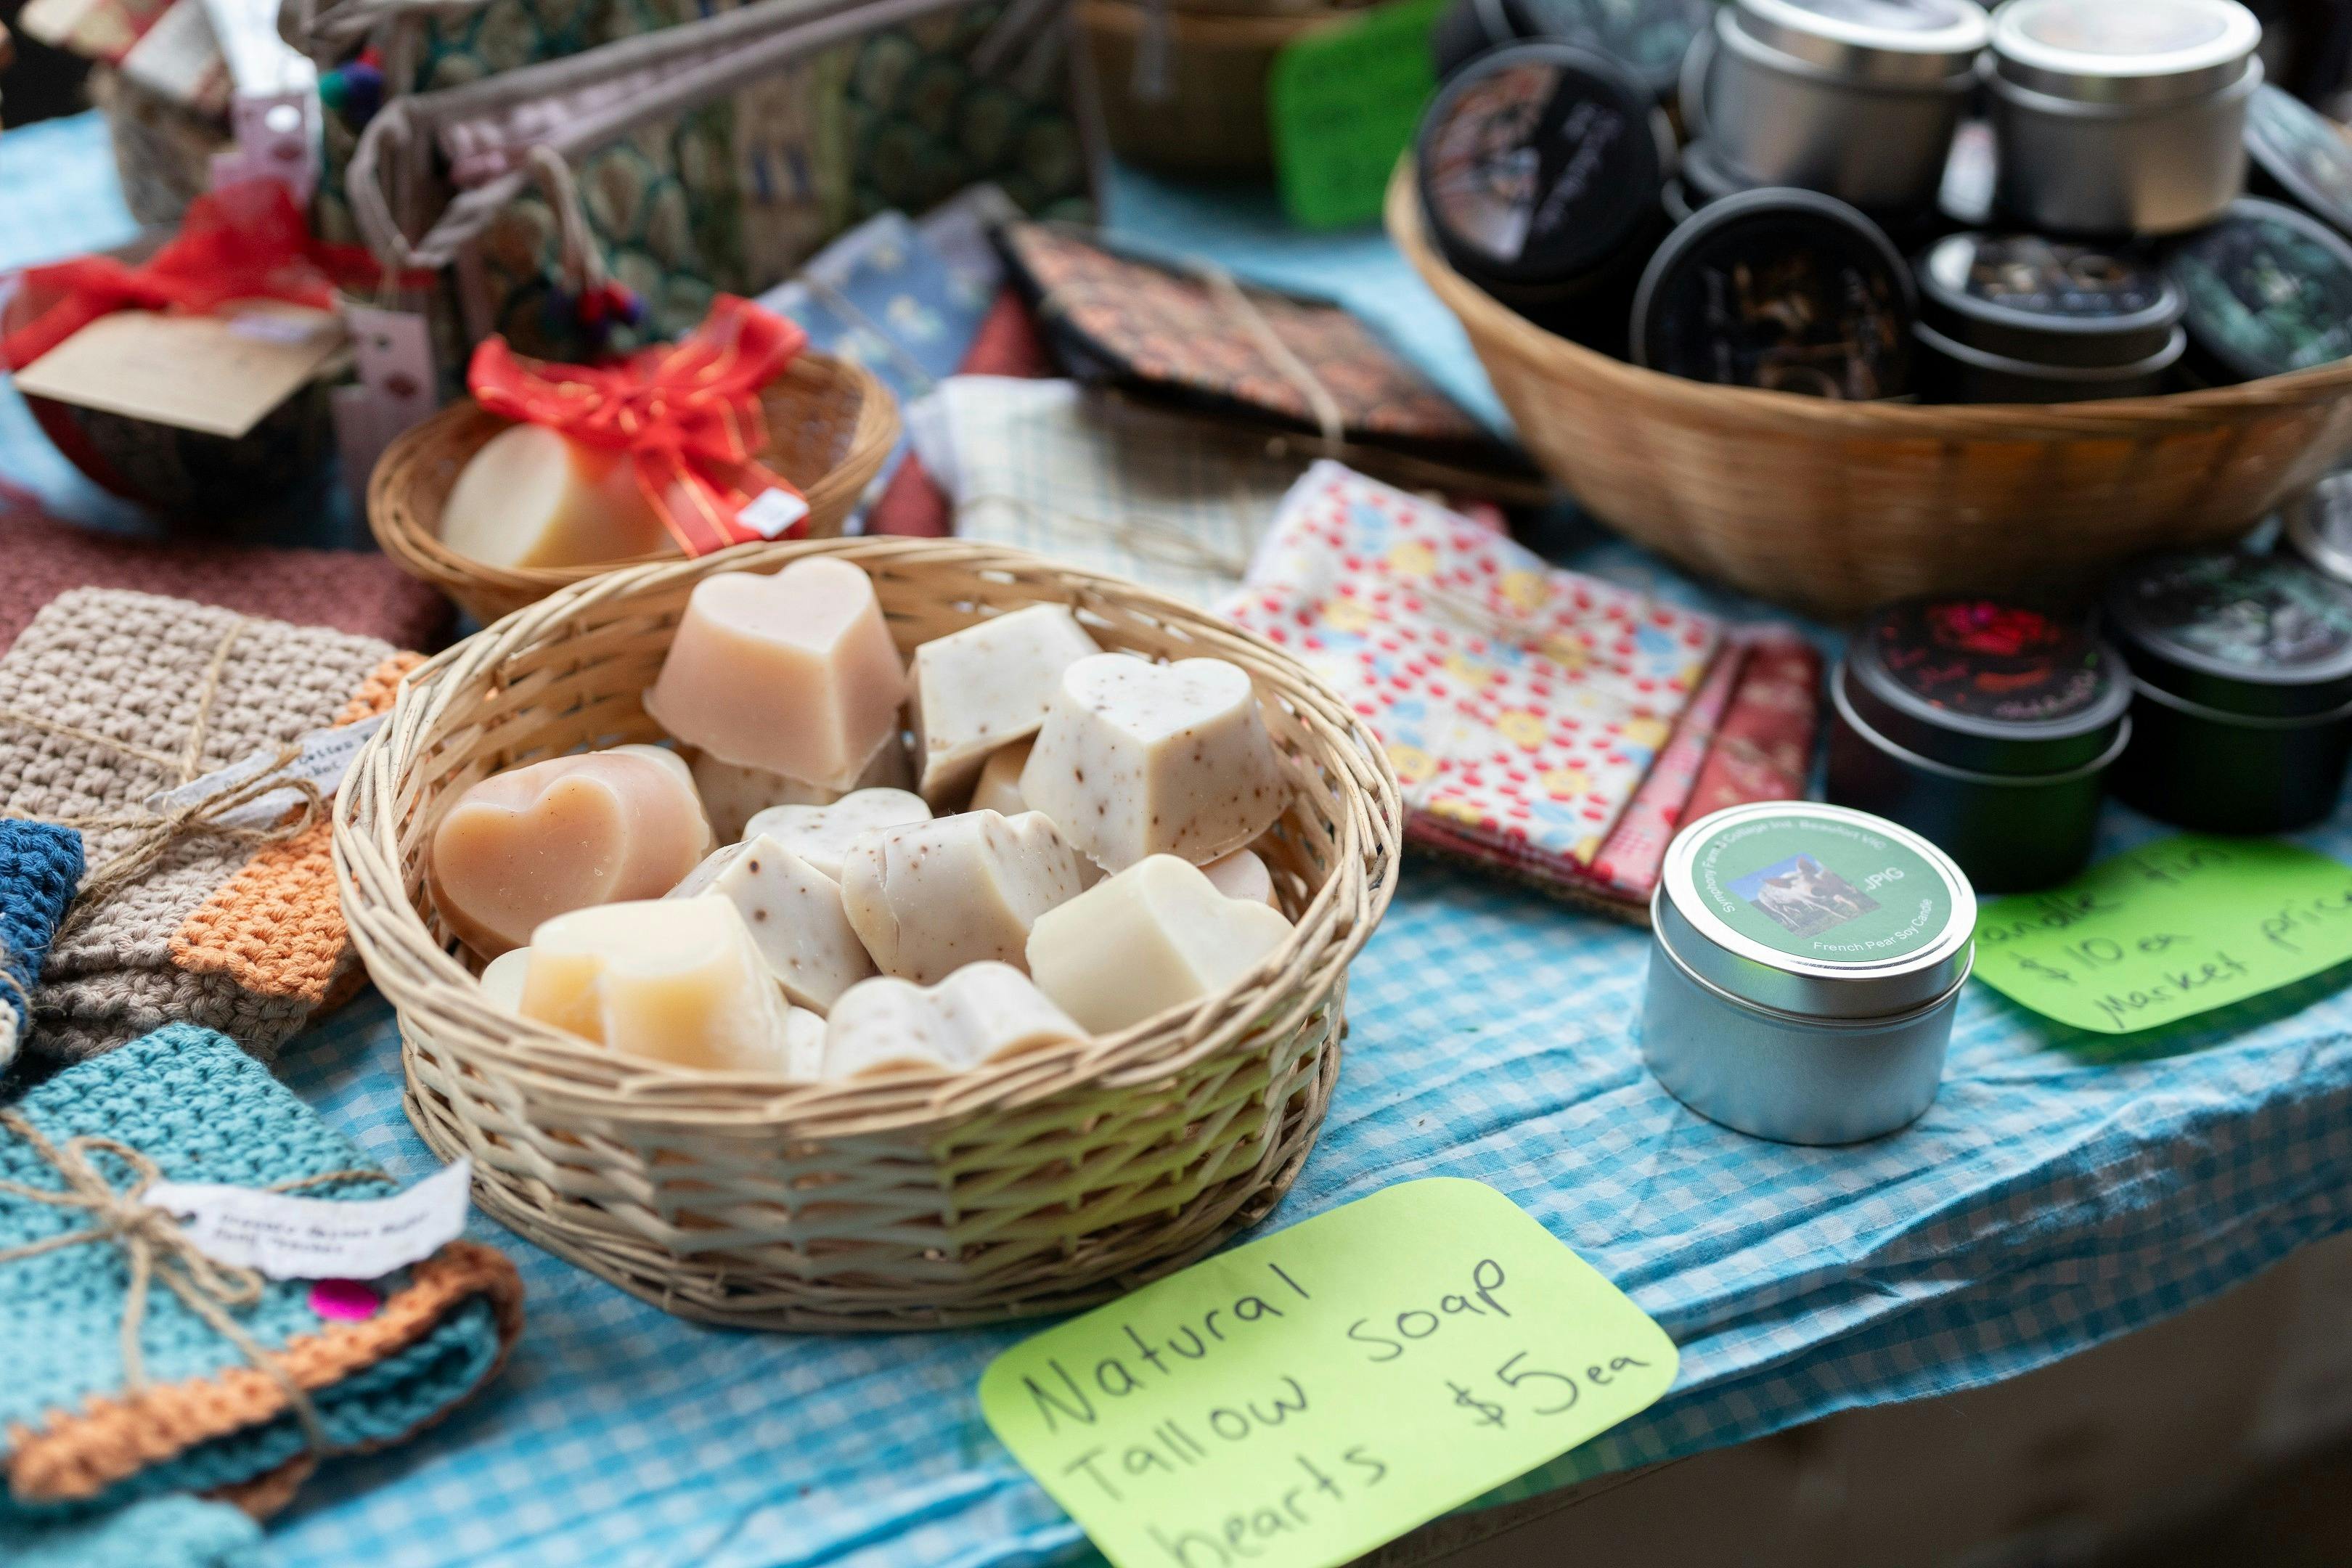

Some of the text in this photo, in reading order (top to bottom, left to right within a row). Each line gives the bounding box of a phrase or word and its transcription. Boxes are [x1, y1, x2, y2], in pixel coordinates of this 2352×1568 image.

[1702, 847, 1721, 868] Farm
[1704, 868, 1736, 912] Symphony
[1813, 899, 1933, 952] French Pear Soy Candle
[1976, 892, 2123, 946] andle
[2008, 937, 2126, 986] $10
[1021, 1262, 1311, 1433] Natural
[1063, 1375, 1310, 1501] Tallow
[1144, 1445, 1386, 1568] hearts
